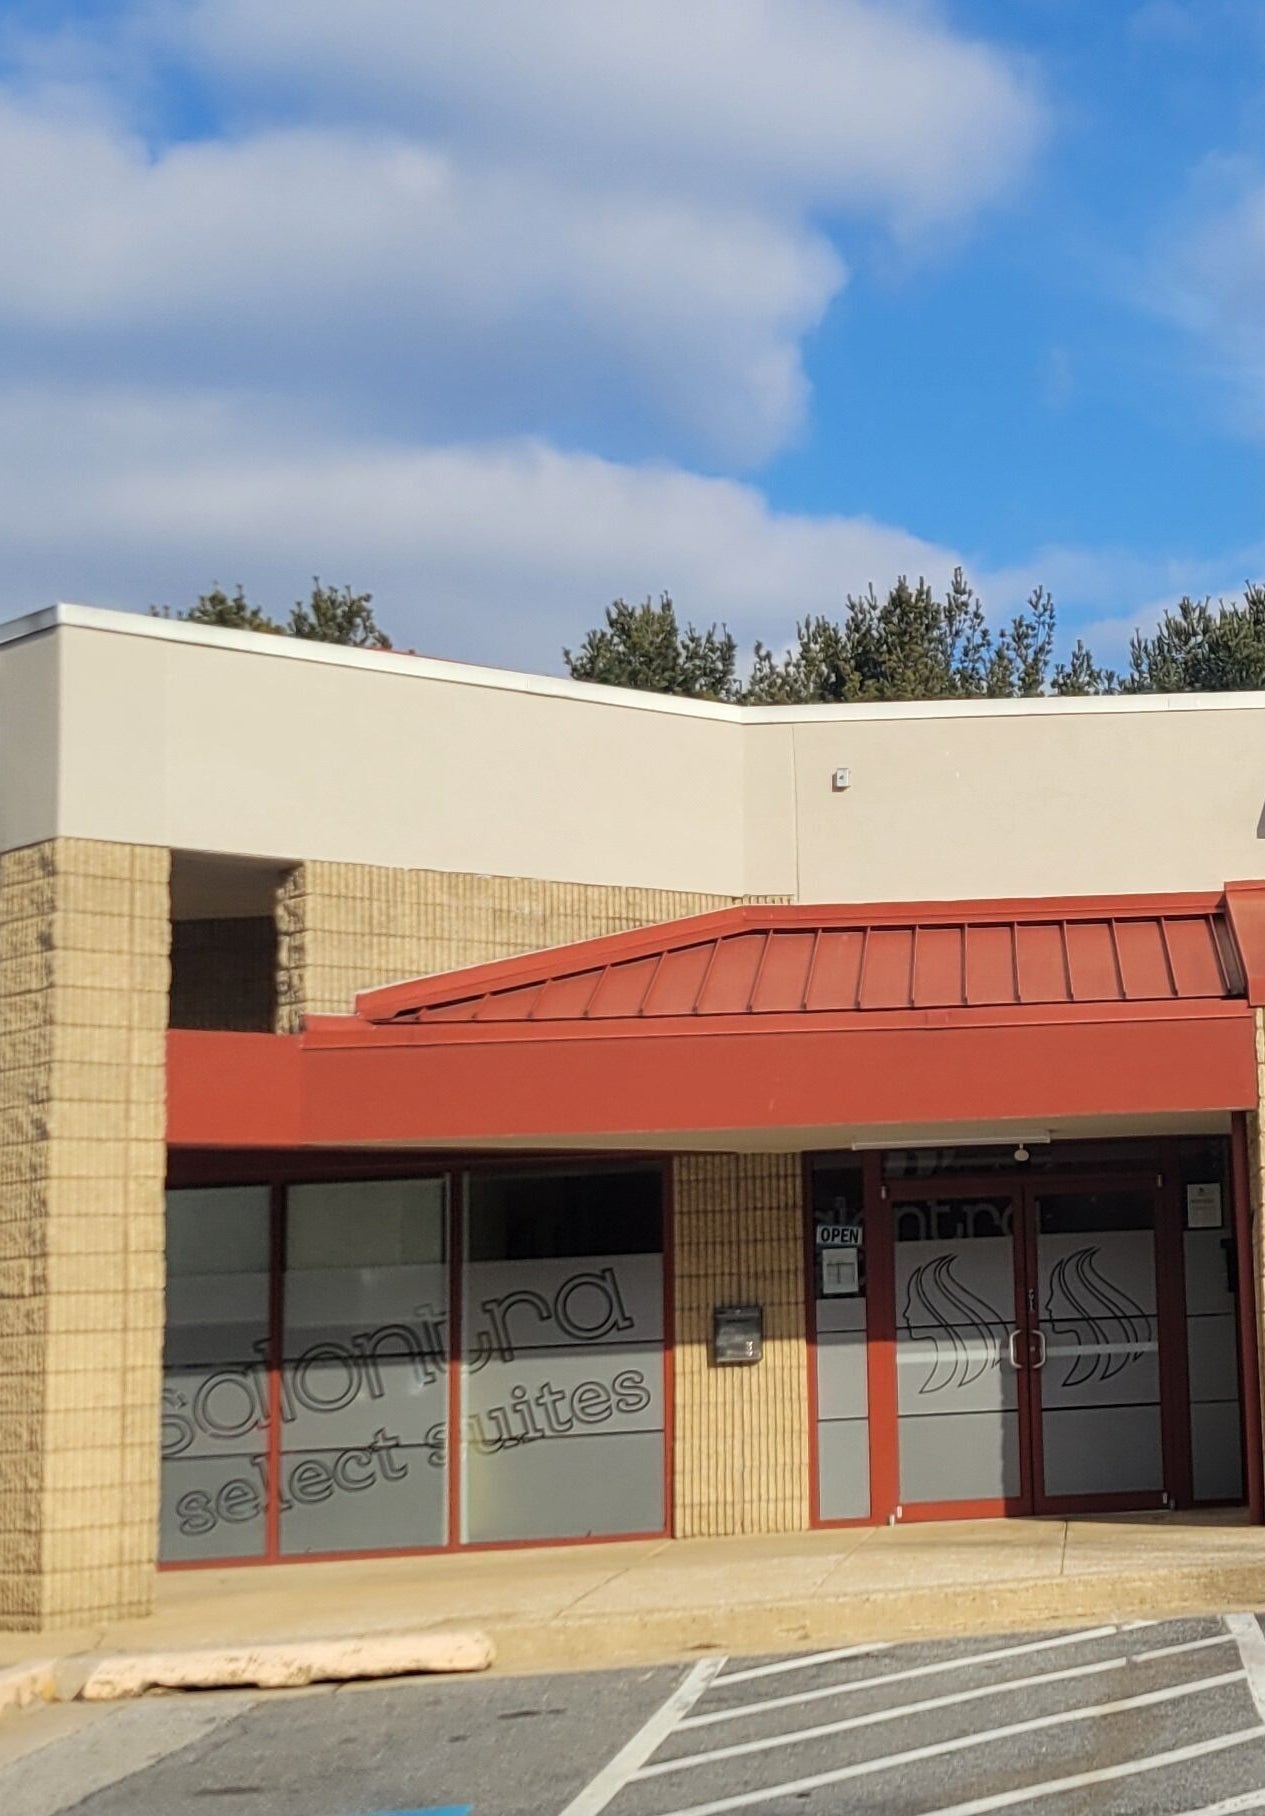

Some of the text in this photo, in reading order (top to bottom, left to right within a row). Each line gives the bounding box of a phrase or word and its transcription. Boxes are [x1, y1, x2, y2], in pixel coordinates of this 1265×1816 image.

[820, 1227, 860, 1244] OPEN
[176, 1369, 651, 1537] select suites
